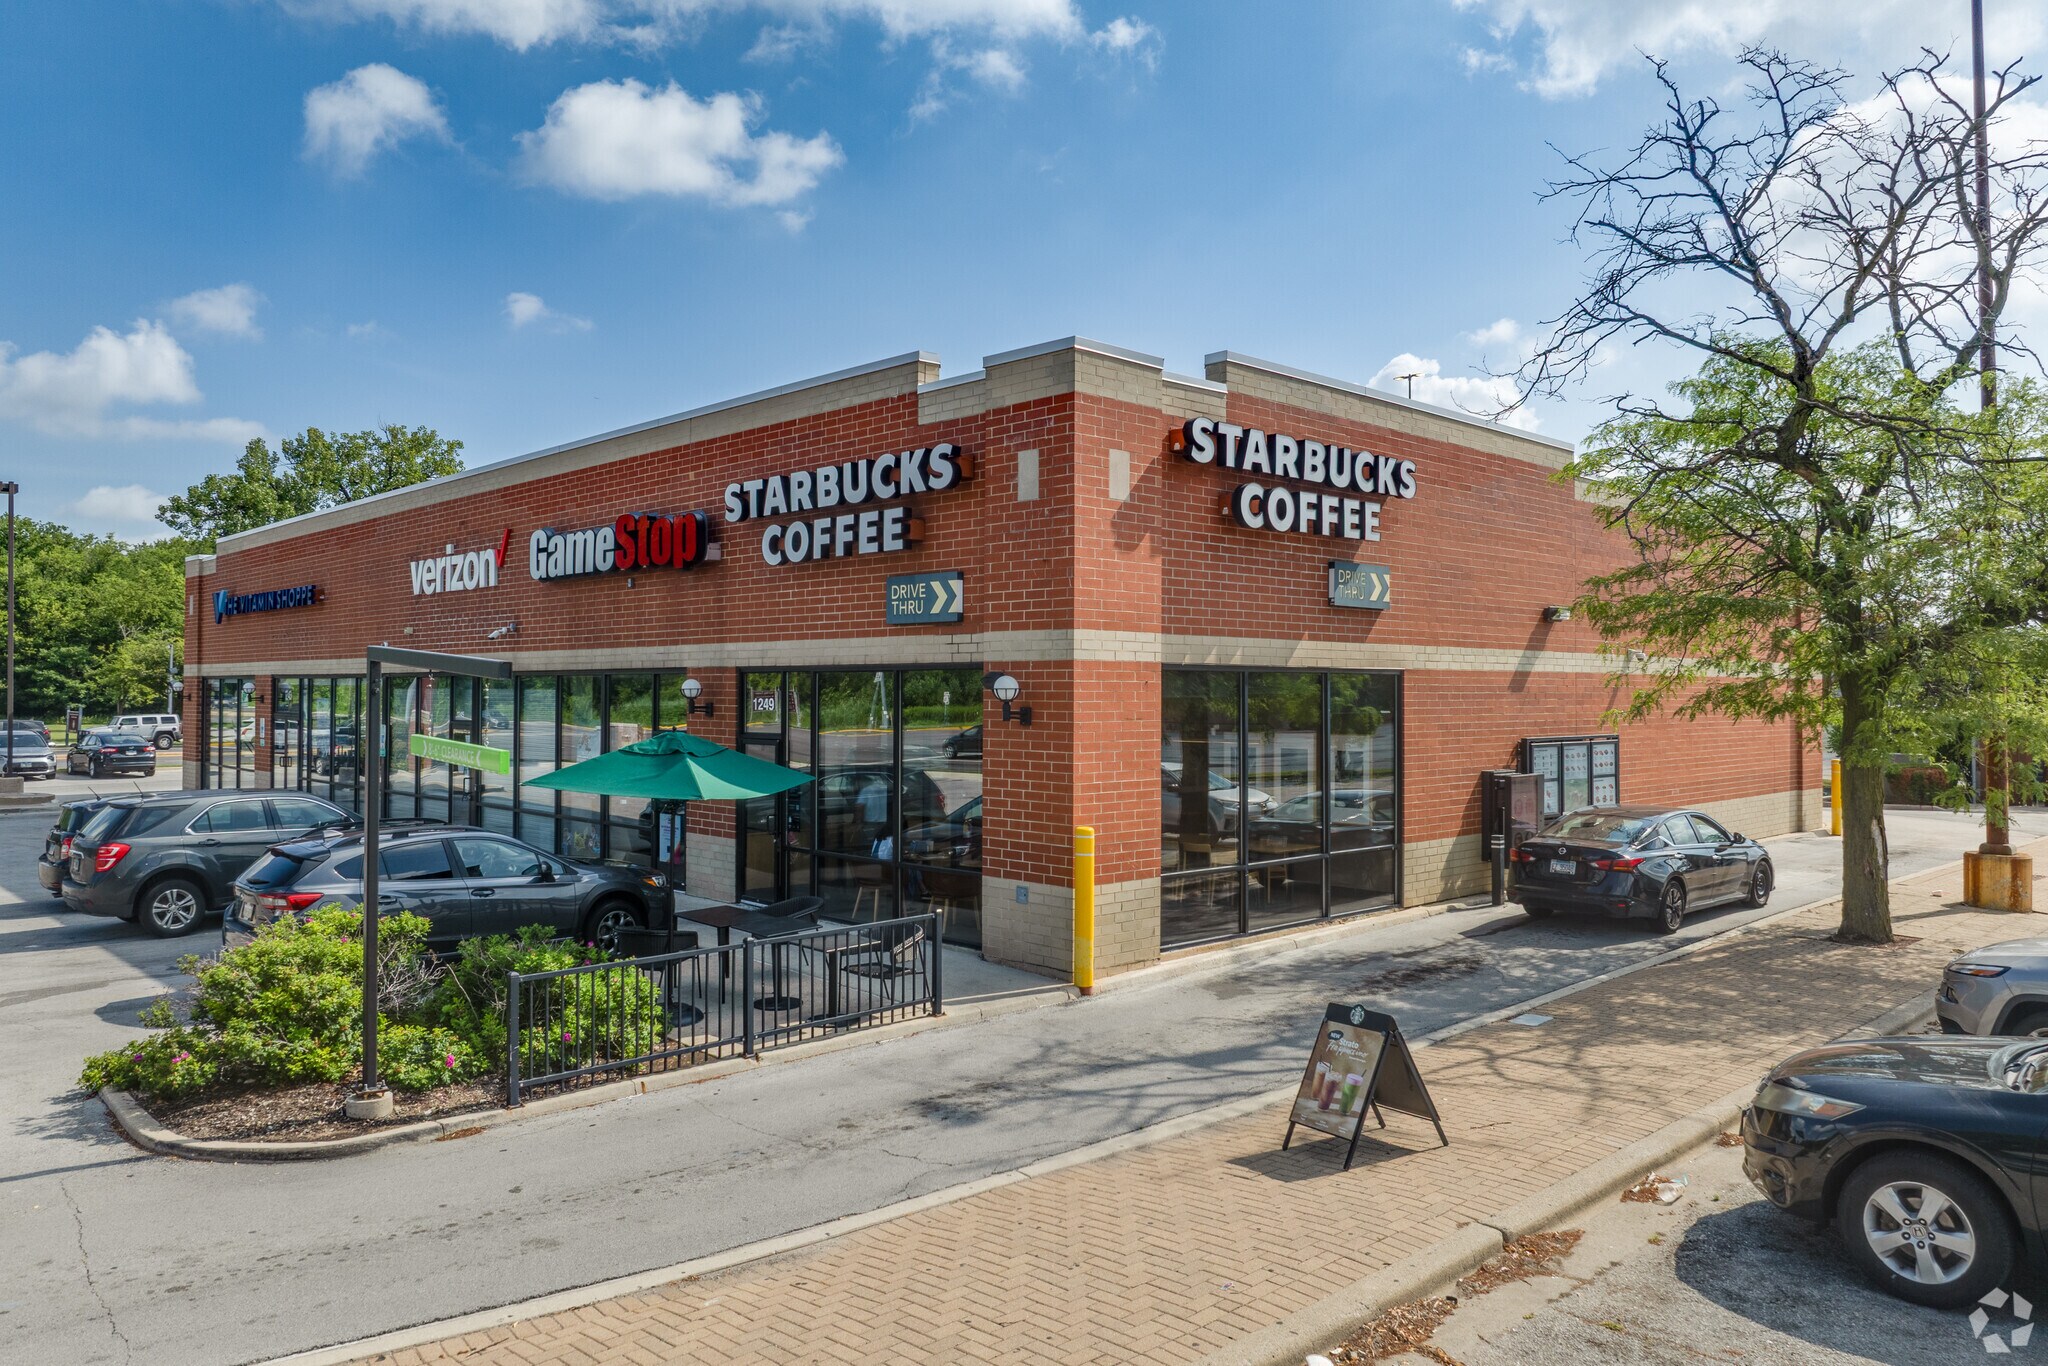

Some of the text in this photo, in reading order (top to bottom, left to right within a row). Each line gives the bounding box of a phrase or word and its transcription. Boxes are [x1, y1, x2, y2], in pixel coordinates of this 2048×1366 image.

[1191, 417, 1417, 499] STARBUCKS
[724, 443, 954, 522] STARBUCKS
[1240, 482, 1382, 542] COFFEE
[529, 513, 697, 580] GameStop
[761, 507, 904, 566] COFFEE
[410, 544, 498, 595] verizon
[1338, 569, 1366, 585] DRIVE
[240, 590, 275, 613] VITAMIN
[276, 585, 313, 609] SHOPPE
[891, 583, 926, 599] DRIVE
[1338, 585, 1365, 600] THRU
[891, 600, 924, 615] THRU
[753, 698, 775, 711] 1249
[441, 746, 475, 764] CLEARANCE
